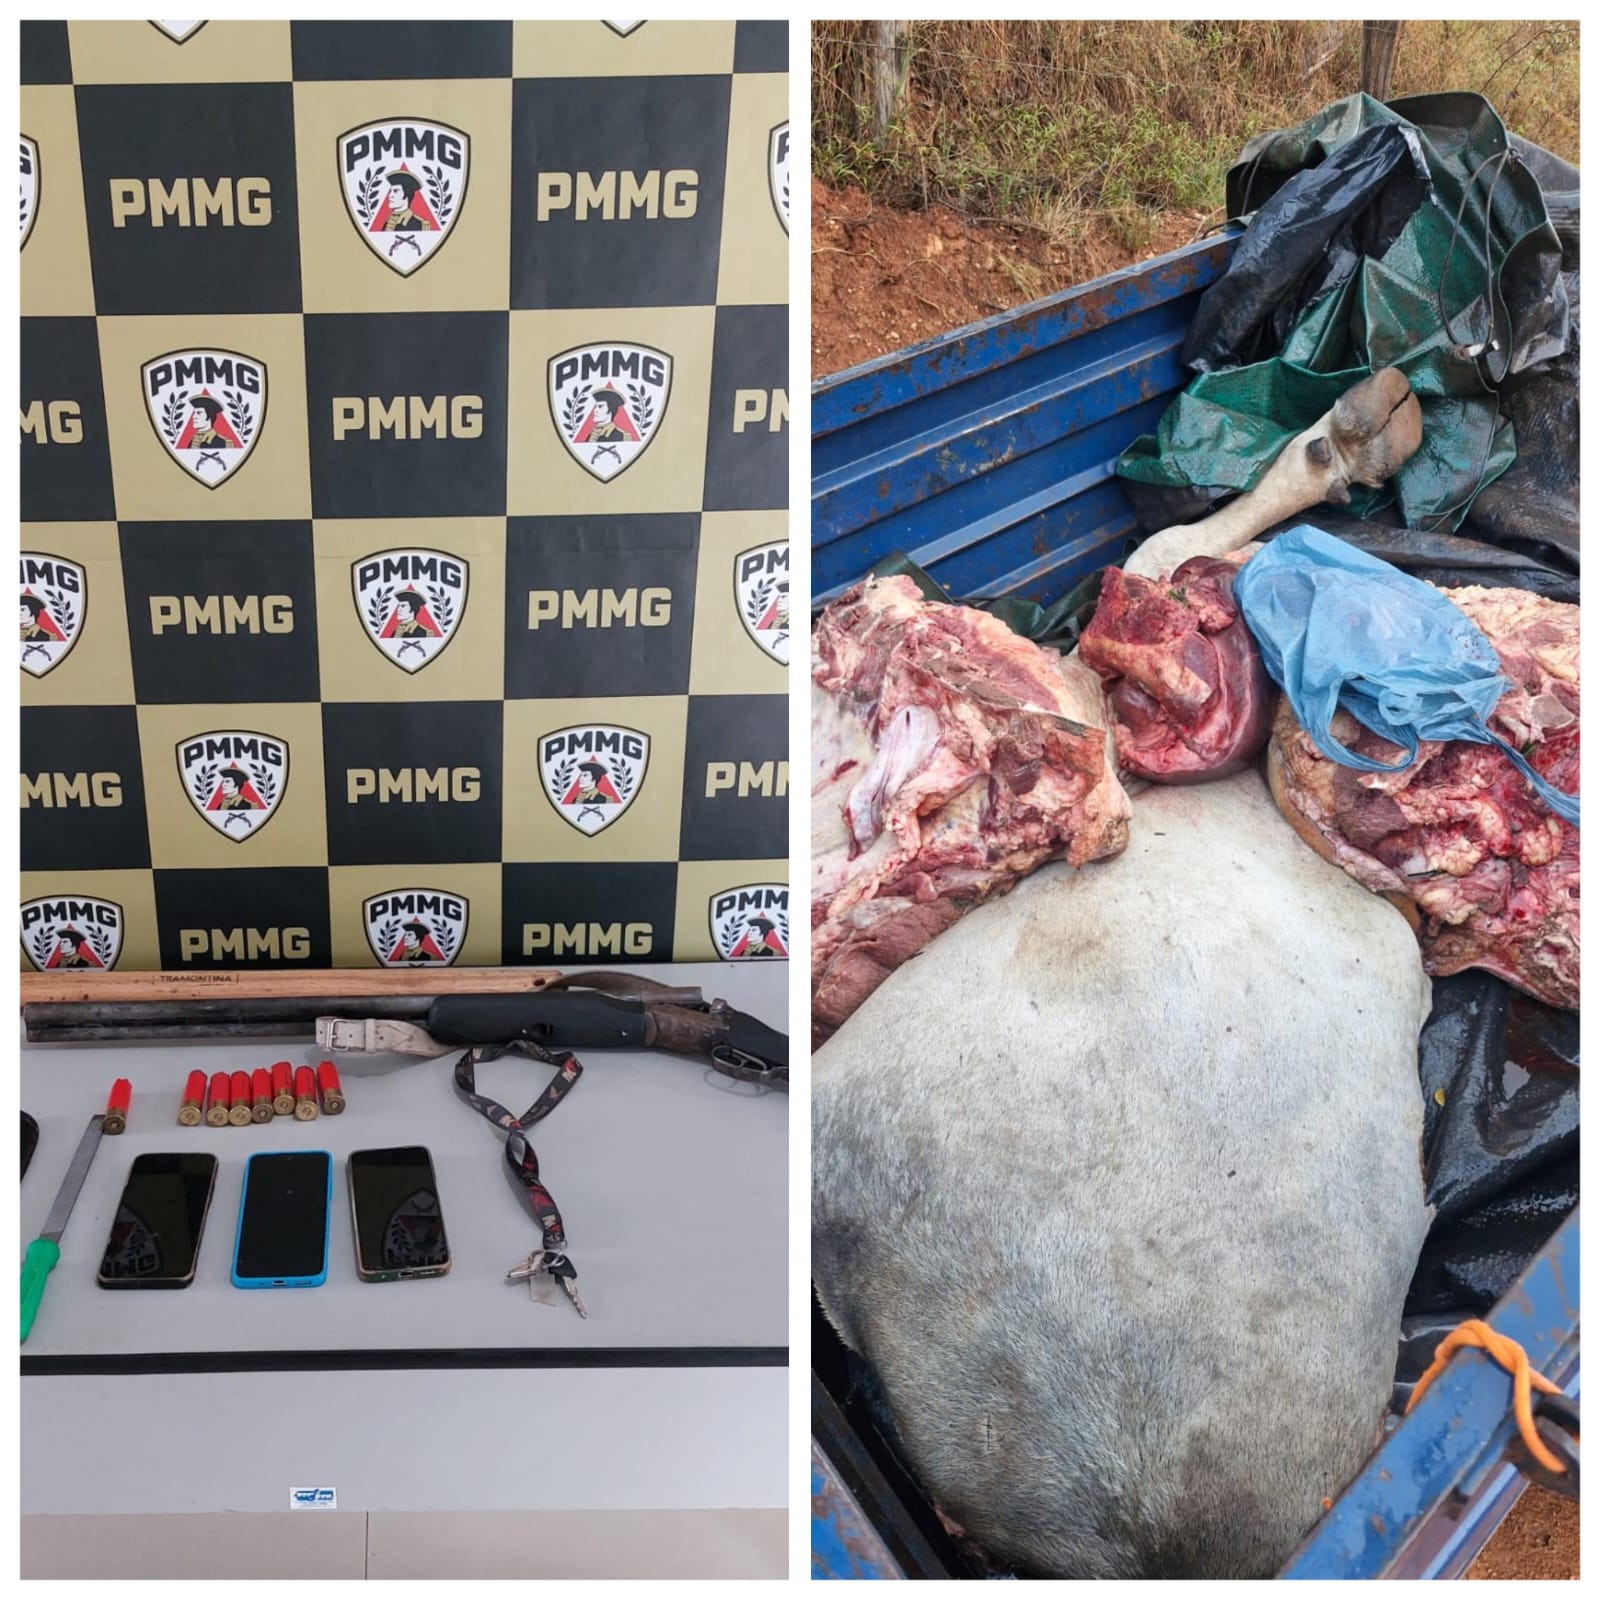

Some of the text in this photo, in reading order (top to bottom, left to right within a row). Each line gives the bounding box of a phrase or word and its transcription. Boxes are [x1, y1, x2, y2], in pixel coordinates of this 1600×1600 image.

[346, 127, 461, 172] PMMG
[110, 177, 272, 227] PMMG
[537, 169, 699, 221] PMMG
[149, 356, 260, 397] PMMG
[555, 350, 665, 390] PMMG
[332, 395, 483, 440] PMMG
[20, 559, 80, 594] MG
[359, 555, 461, 592] PMMG
[149, 595, 294, 635] PMMG
[528, 587, 672, 630] PMMG
[183, 737, 282, 768] PMMG
[544, 730, 643, 763] PMMG
[20, 772, 123, 808] MMG
[346, 766, 481, 804] PMMG
[21, 900, 117, 931] PMMG
[369, 894, 462, 924] PMMG
[715, 889, 789, 919] PMM
[180, 926, 311, 961] PMMG
[523, 922, 653, 956] PMMG
[160, 975, 232, 983] TRAMONTINA
